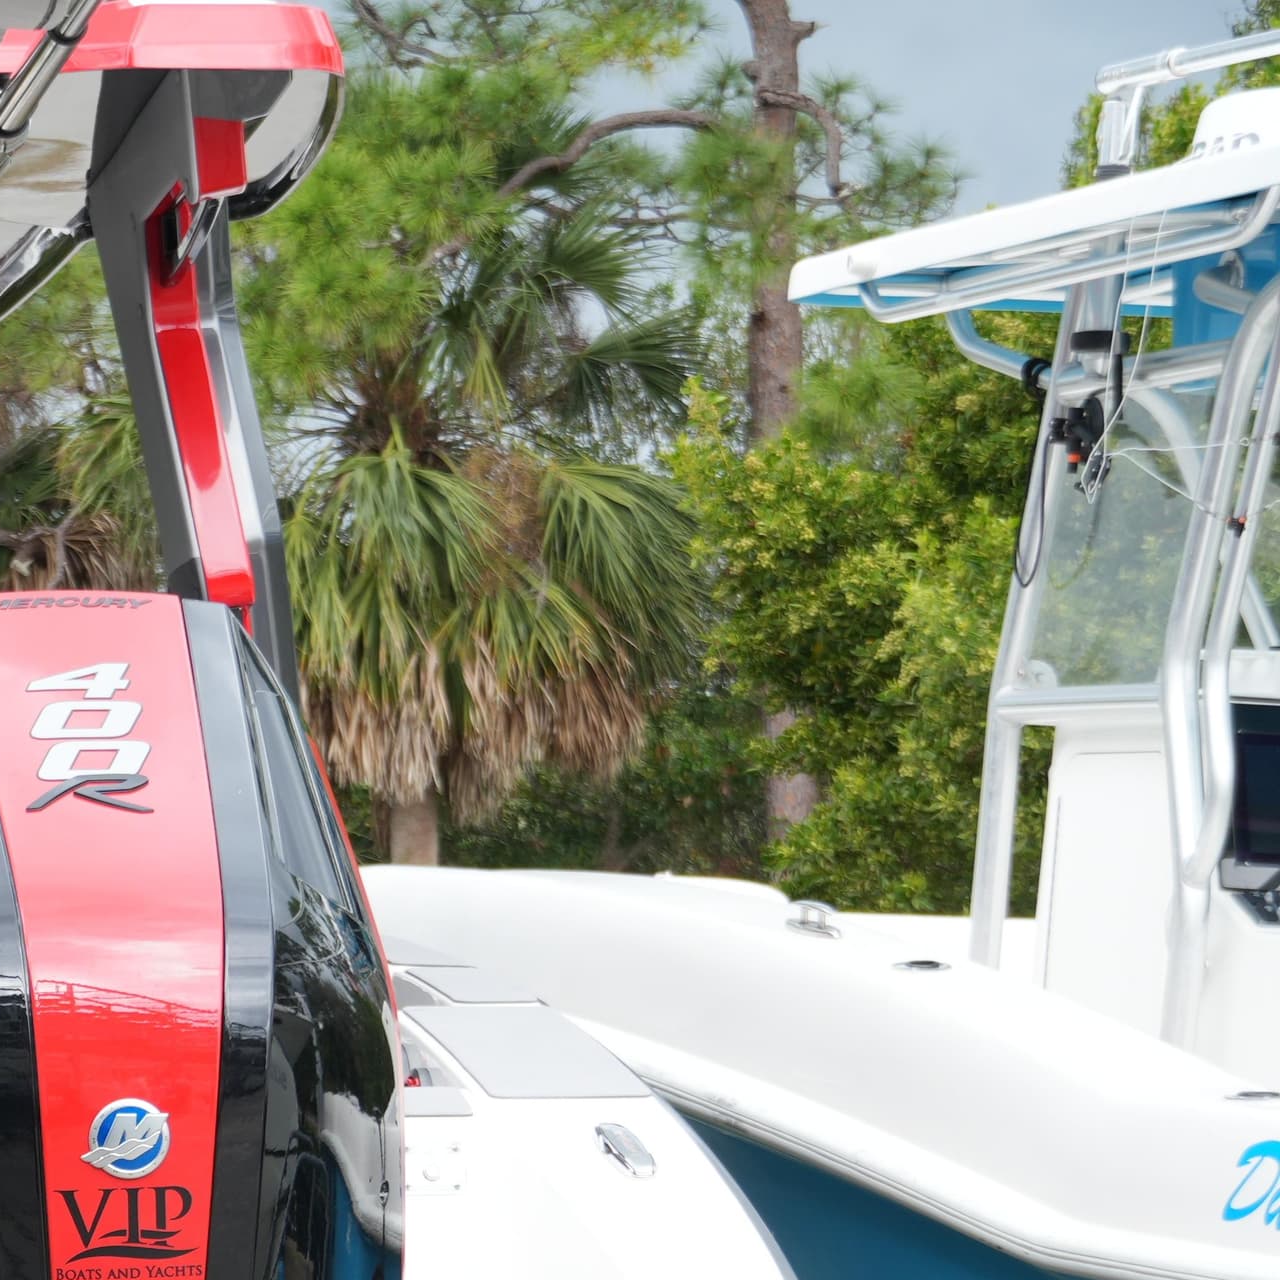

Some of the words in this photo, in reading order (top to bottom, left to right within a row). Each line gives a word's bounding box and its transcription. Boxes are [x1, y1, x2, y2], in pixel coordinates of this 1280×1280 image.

[53, 1186, 192, 1248] VIP
[56, 1268, 102, 1280] BOATS
[107, 1268, 140, 1279] AND
[145, 1265, 202, 1278] YACHTS
